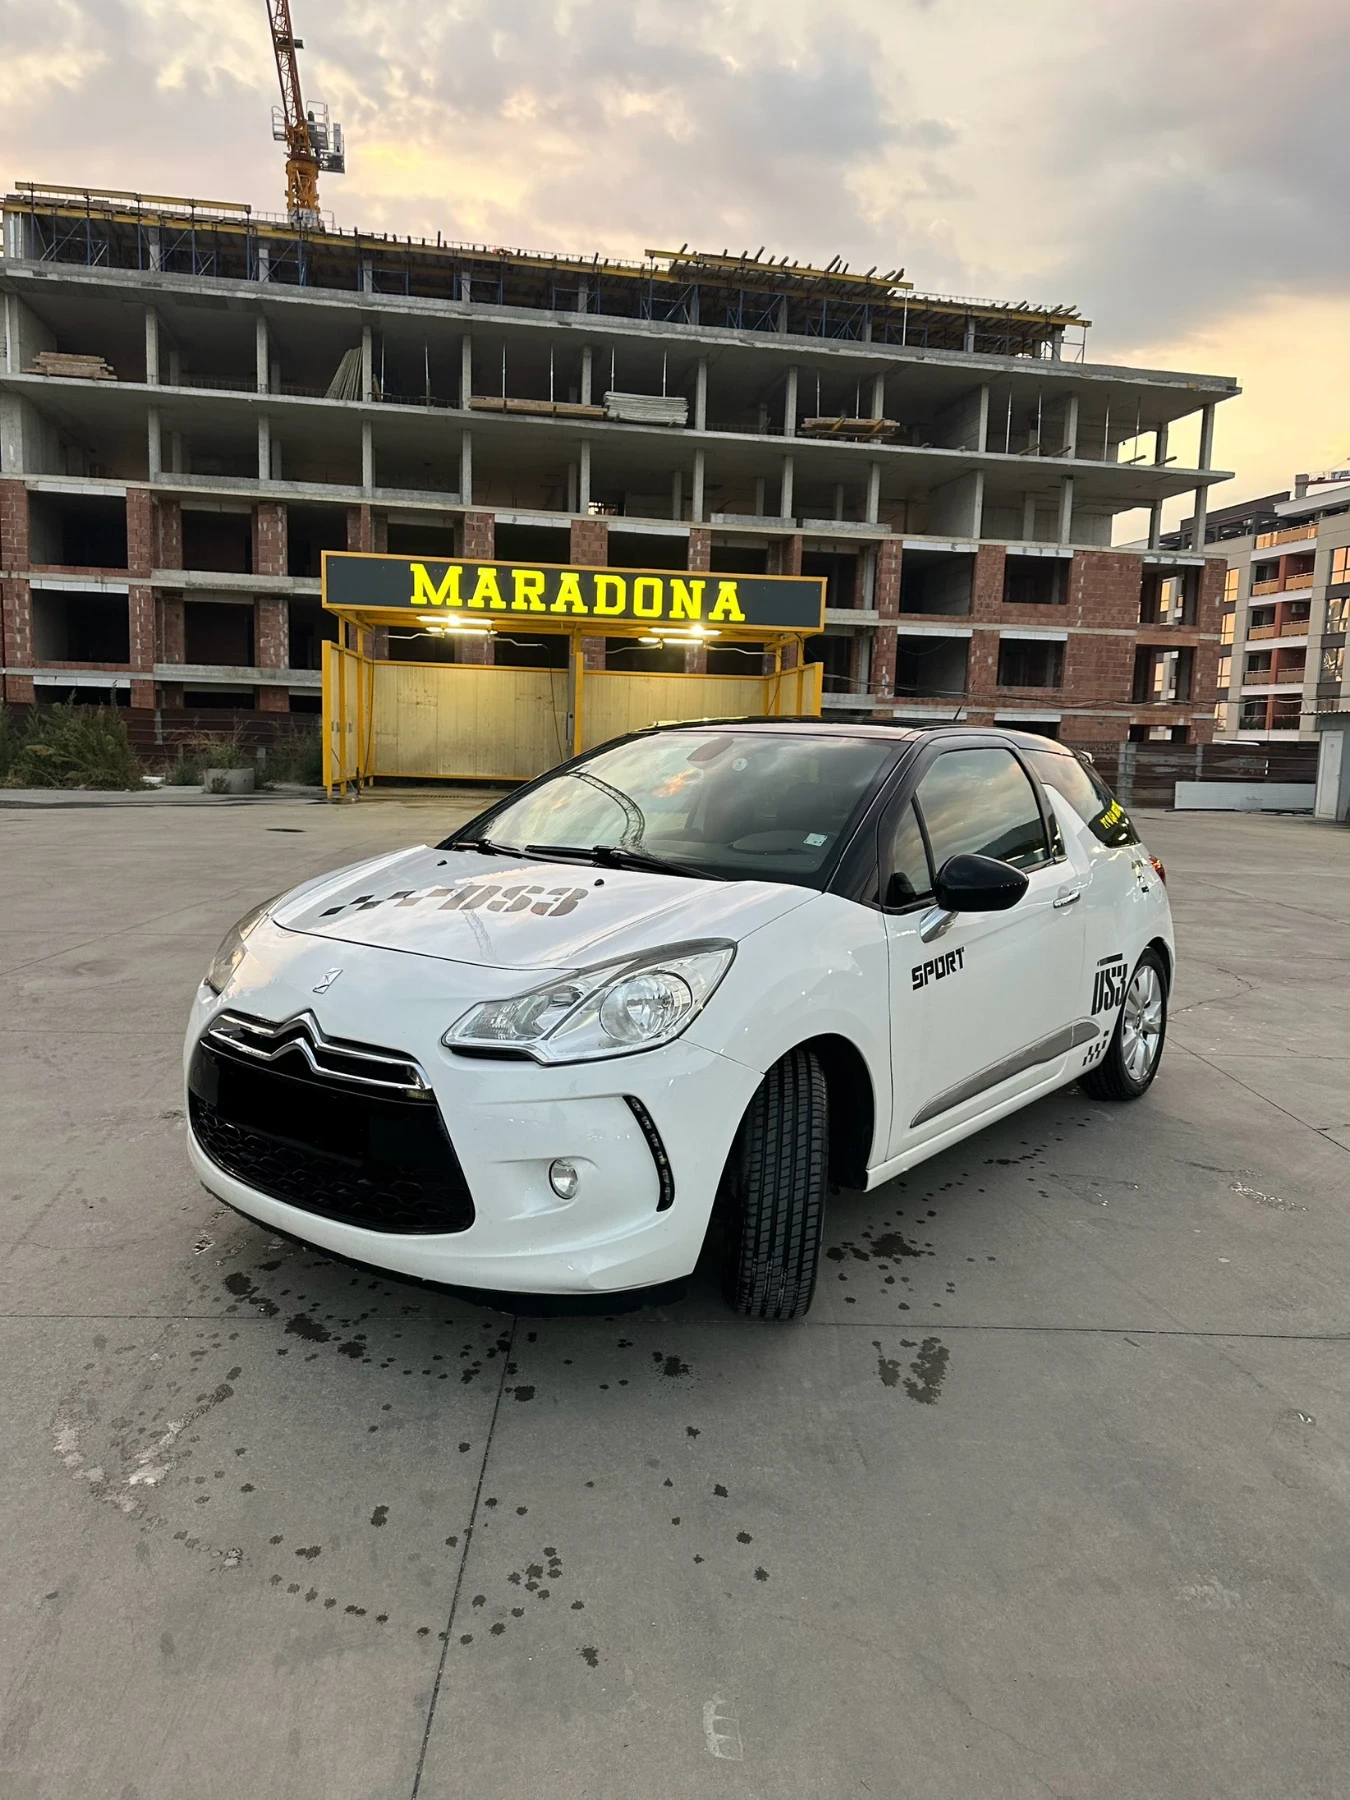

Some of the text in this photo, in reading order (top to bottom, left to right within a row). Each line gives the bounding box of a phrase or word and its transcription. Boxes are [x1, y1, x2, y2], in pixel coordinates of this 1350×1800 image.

[410, 563, 745, 621] MARADONA
[438, 885, 589, 916] DS3
[911, 946, 965, 991] SPORT
[1091, 962, 1128, 1016] DS3
